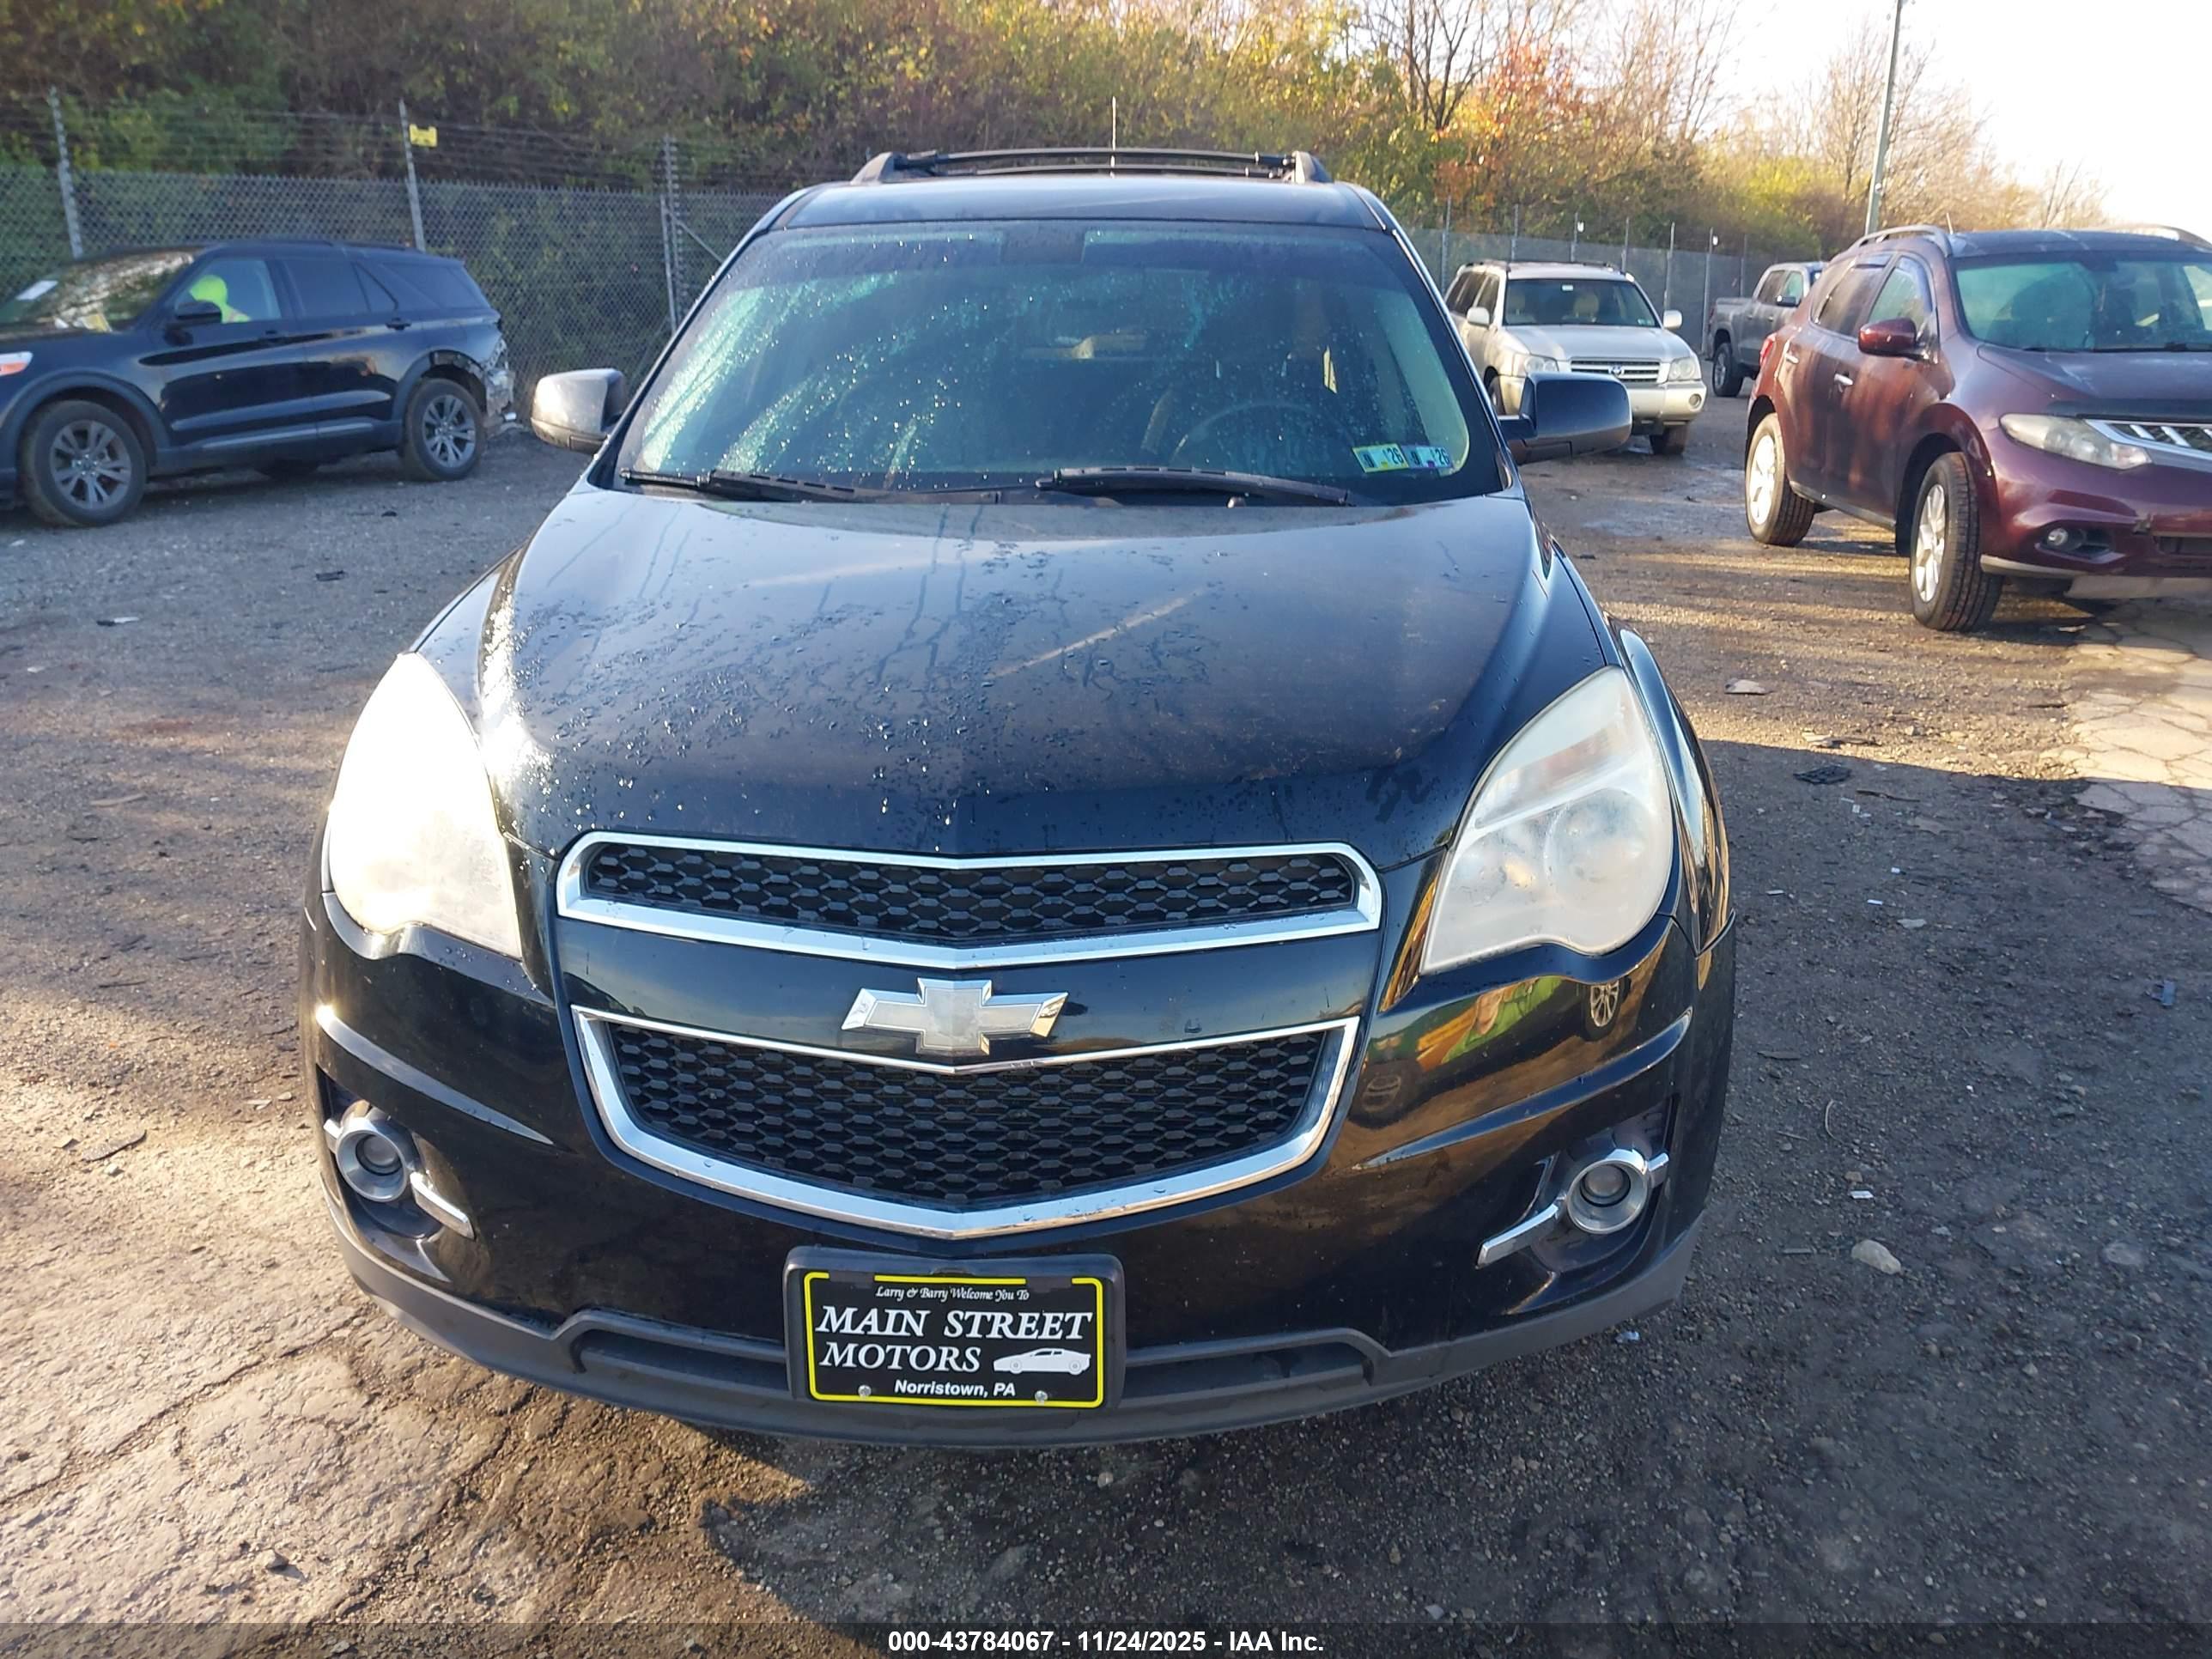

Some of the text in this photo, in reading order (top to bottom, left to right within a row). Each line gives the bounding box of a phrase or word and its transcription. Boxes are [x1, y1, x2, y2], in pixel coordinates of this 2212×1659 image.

[875, 1285, 1030, 1304] Larry & Barry Welcome You To
[815, 1305, 1094, 1340] MAIN STREET
[818, 1341, 981, 1372] MOTORS
[894, 1379, 1016, 1398] Norristown, PA
